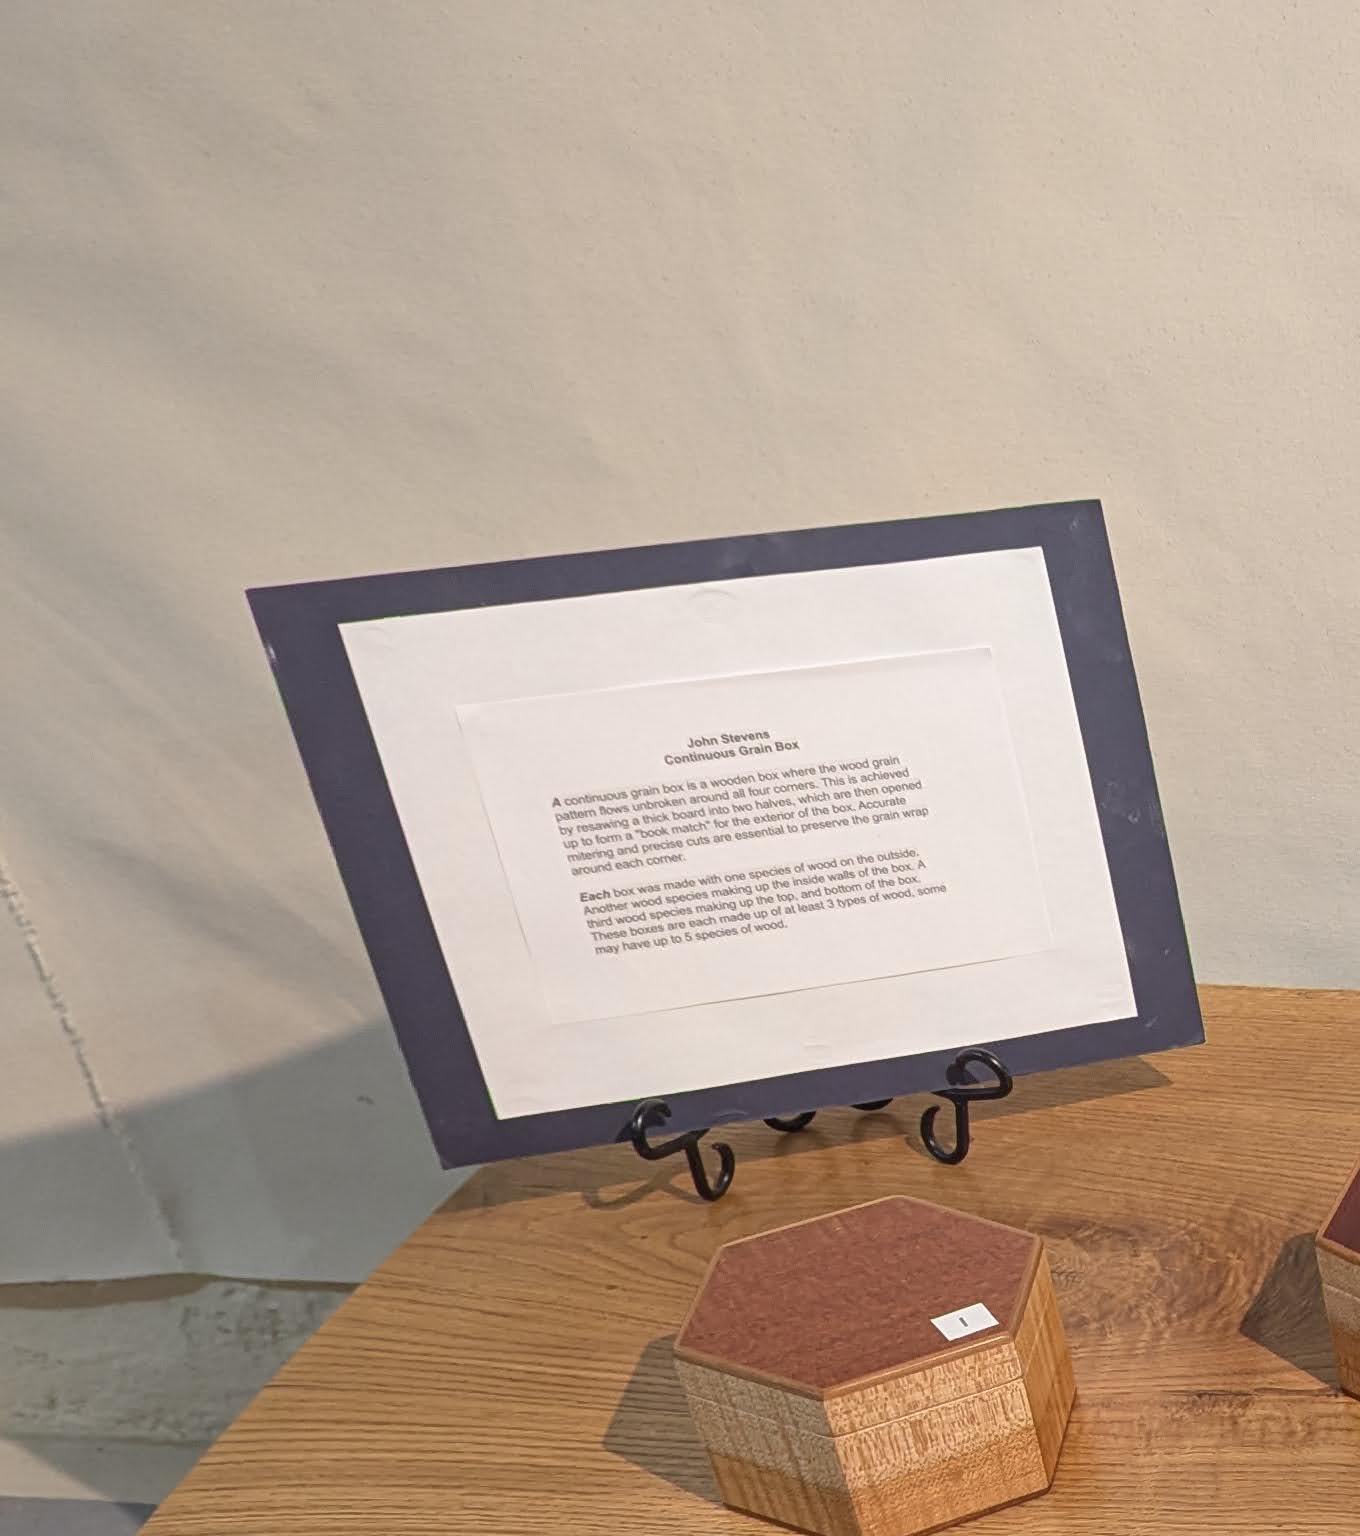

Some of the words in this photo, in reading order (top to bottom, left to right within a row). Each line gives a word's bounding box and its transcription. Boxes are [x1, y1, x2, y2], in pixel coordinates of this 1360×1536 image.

[663, 749, 737, 766] Continuous
[738, 743, 774, 757] Grain
[774, 741, 800, 752] Box
[687, 735, 719, 749] John
[720, 731, 771, 745] Stevens
[551, 797, 562, 809] A
[563, 791, 629, 807] continuous
[629, 785, 661, 801] grain
[661, 783, 685, 794] box
[686, 780, 698, 791] is
[699, 780, 709, 790] a
[709, 774, 757, 788] wooden
[756, 771, 780, 783] box
[780, 767, 817, 779] where
[817, 763, 837, 775] the
[838, 758, 870, 772] wood
[871, 755, 901, 771] grain
[631, 797, 687, 812] unbroken
[689, 789, 731, 805] around
[732, 788, 747, 800] all
[747, 786, 771, 797] four
[819, 776, 846, 788] This
[846, 774, 859, 785] is
[859, 767, 910, 784] achieved
[557, 825, 574, 837] by
[575, 818, 630, 833] resawing
[631, 817, 641, 826] a
[641, 811, 671, 825] thick
[671, 807, 707, 821] board
[707, 805, 731, 816] into
[731, 803, 754, 814] two
[797, 791, 832, 805] which
[832, 790, 852, 801] are
[853, 786, 880, 798] then
[880, 779, 923, 796] opened
[579, 889, 612, 903] Each
[611, 887, 637, 898] box
[636, 884, 662, 894] was
[663, 878, 697, 891] made
[697, 873, 723, 886] with
[723, 872, 747, 883] one
[748, 866, 793, 881] species
[793, 862, 806, 874] of
[806, 857, 838, 872] wood
[839, 857, 855, 867] on
[856, 854, 875, 865] the
[583, 902, 629, 916] Another
[630, 895, 663, 909] wood
[664, 891, 709, 905] species
[710, 884, 754, 898] making
[754, 882, 771, 894] up
[771, 879, 791, 890] the
[791, 874, 826, 887] inside
[826, 869, 857, 882] walls
[857, 866, 870, 878] of
[870, 865, 890, 876] the
[917, 859, 927, 870] A
[594, 944, 620, 955] may
[621, 939, 652, 951] have
[652, 937, 669, 948] up
[669, 934, 683, 945] to
[683, 931, 694, 943] 5
[694, 927, 740, 942] species
[739, 922, 753, 935] of
